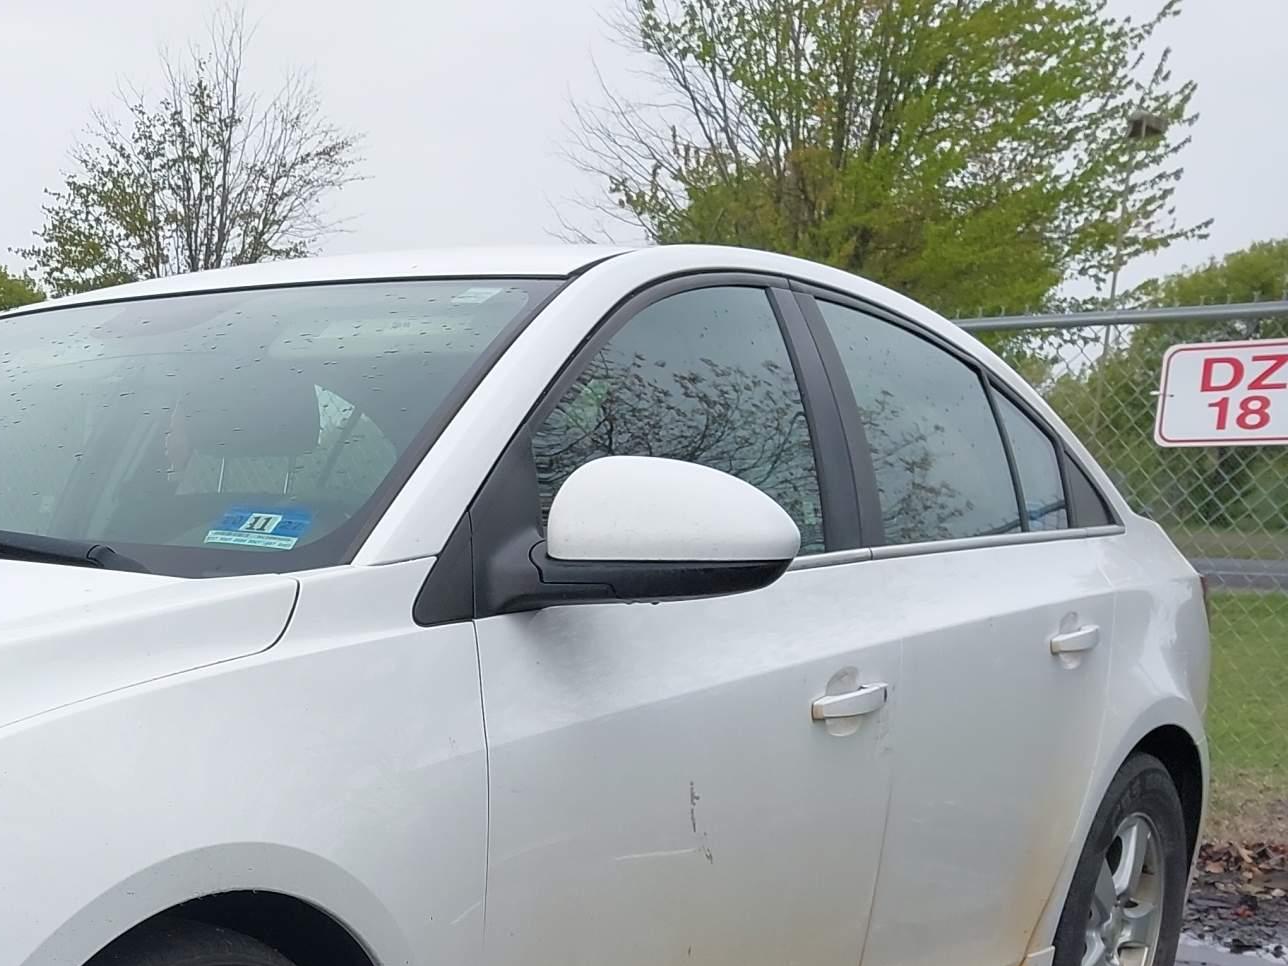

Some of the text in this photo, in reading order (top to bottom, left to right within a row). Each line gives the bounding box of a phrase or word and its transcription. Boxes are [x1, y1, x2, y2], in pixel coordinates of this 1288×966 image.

[1200, 355, 1288, 392] DZ
[1208, 396, 1271, 430] 18
[245, 515, 272, 531] 11
